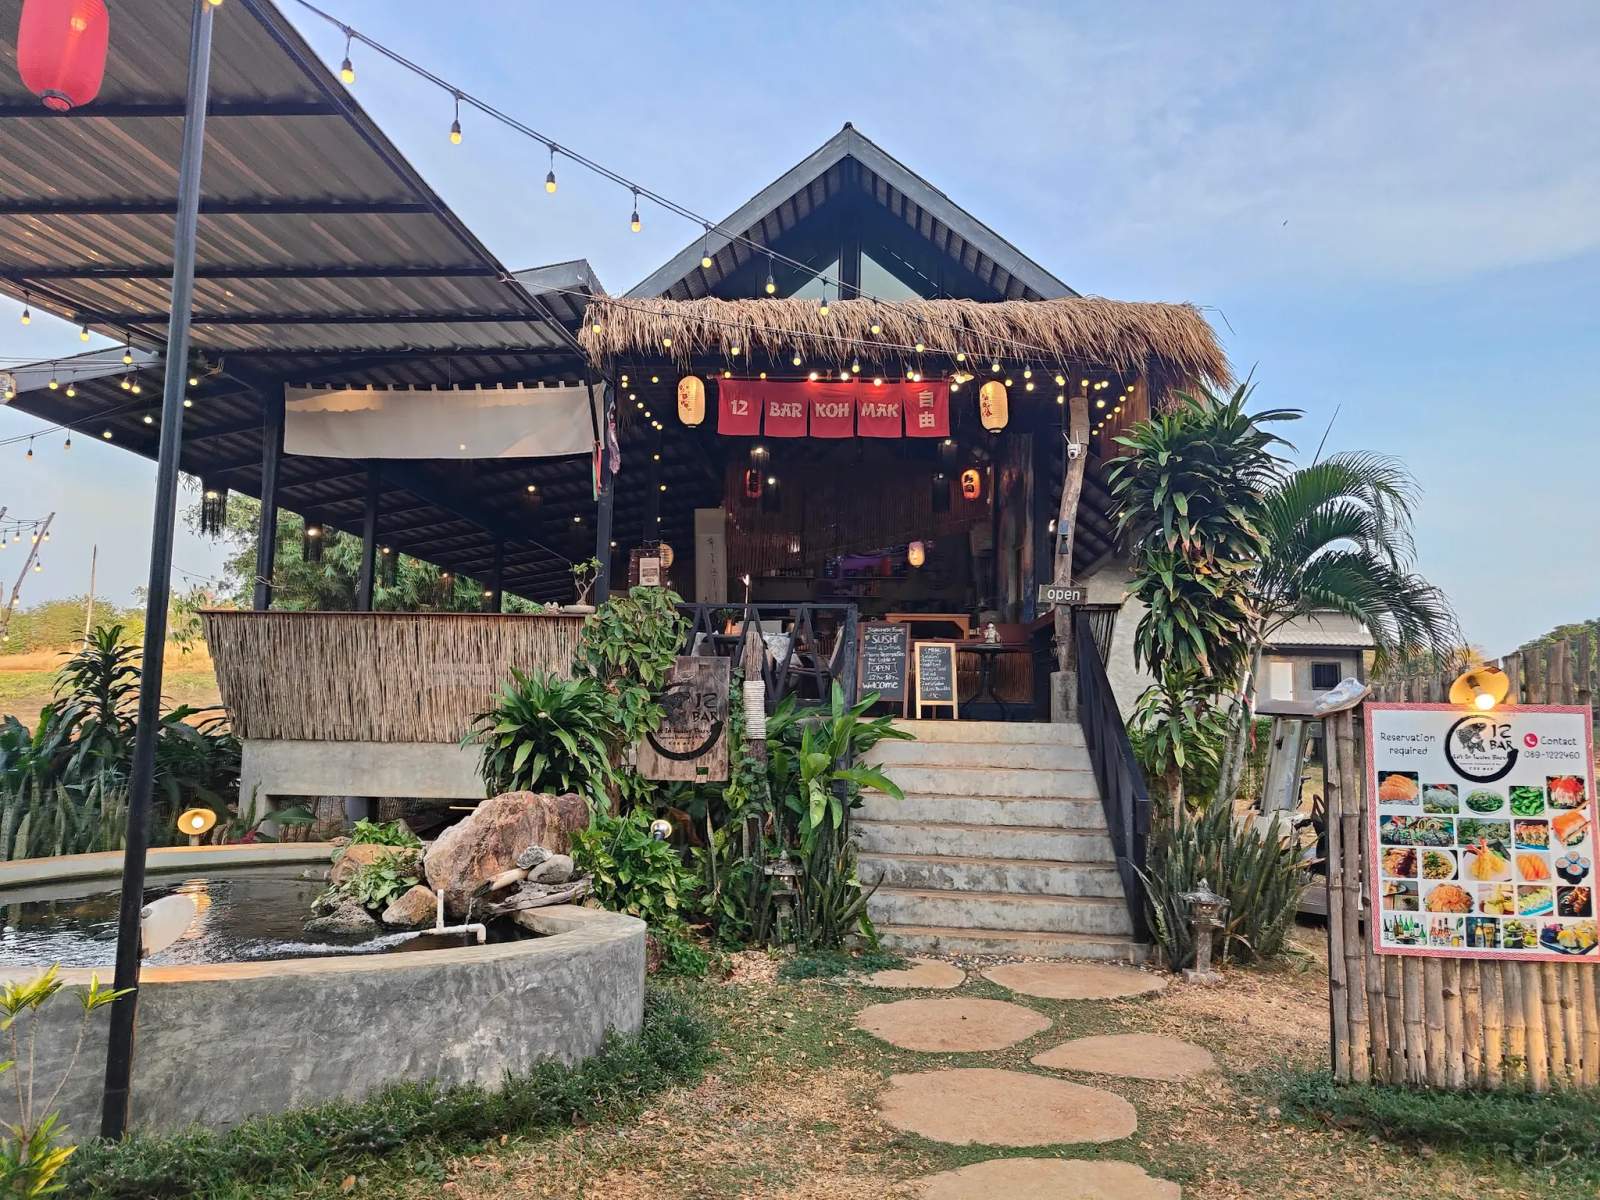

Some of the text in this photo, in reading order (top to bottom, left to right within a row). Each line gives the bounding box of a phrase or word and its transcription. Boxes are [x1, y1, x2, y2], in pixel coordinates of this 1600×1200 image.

[730, 399, 899, 418] 12 BAR KOH MAK
[919, 389, 936, 429] 自由
[1047, 589, 1080, 602] open
[695, 693, 717, 708] 12
[692, 711, 719, 722] BAR
[1491, 724, 1512, 738] 12
[1380, 732, 1436, 742] Reservation
[1541, 736, 1577, 746] Contact
[1489, 740, 1514, 751] BAR
[1389, 747, 1428, 756] required
[1523, 750, 1580, 760] 089-1222460
